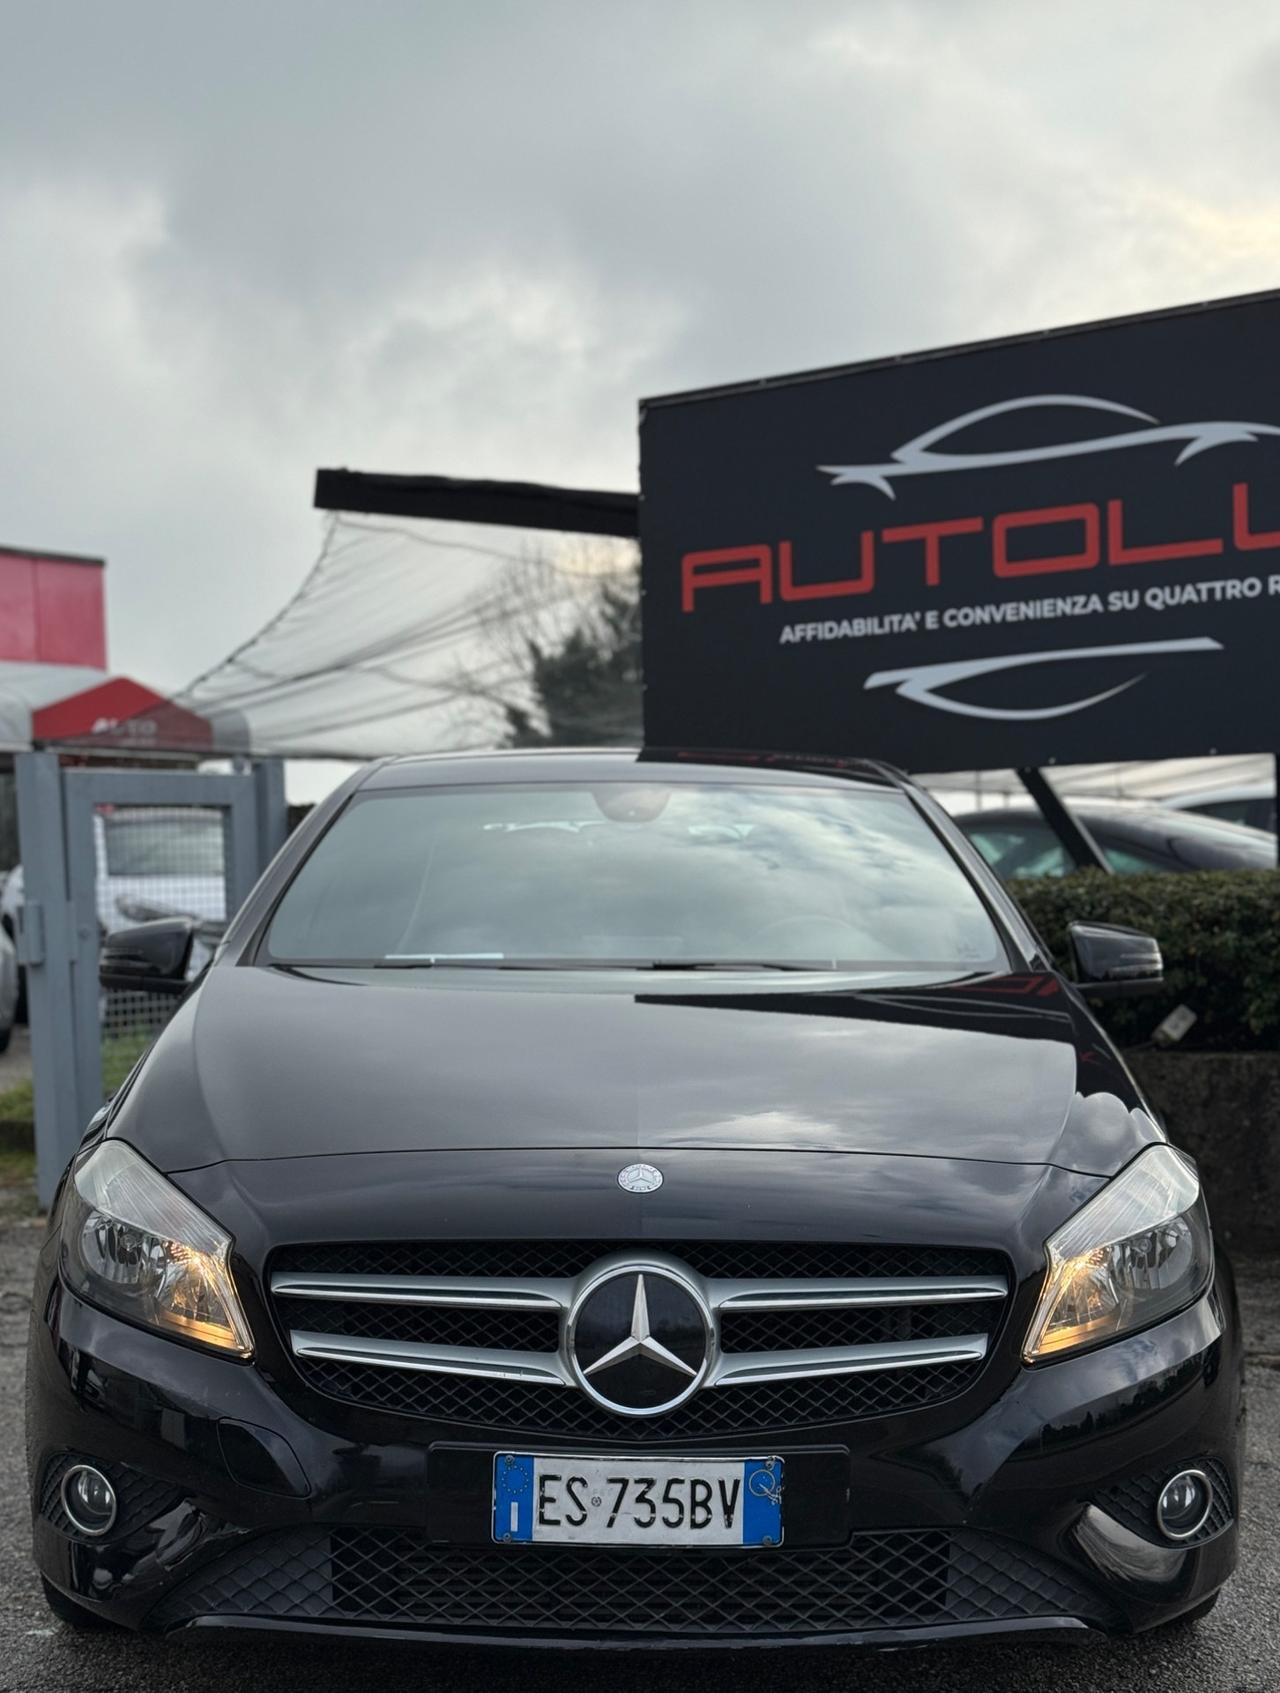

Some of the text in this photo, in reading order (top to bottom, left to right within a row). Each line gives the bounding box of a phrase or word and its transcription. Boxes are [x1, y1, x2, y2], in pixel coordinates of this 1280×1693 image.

[779, 611, 921, 644] AFFIDABILITA'
[925, 610, 939, 630] E
[943, 593, 1104, 628] CONVENIENZA
[1107, 589, 1140, 612] SU
[1144, 576, 1263, 611] QUATTRO
[538, 1474, 588, 1527] ES
[606, 1477, 741, 1529] 735BV
